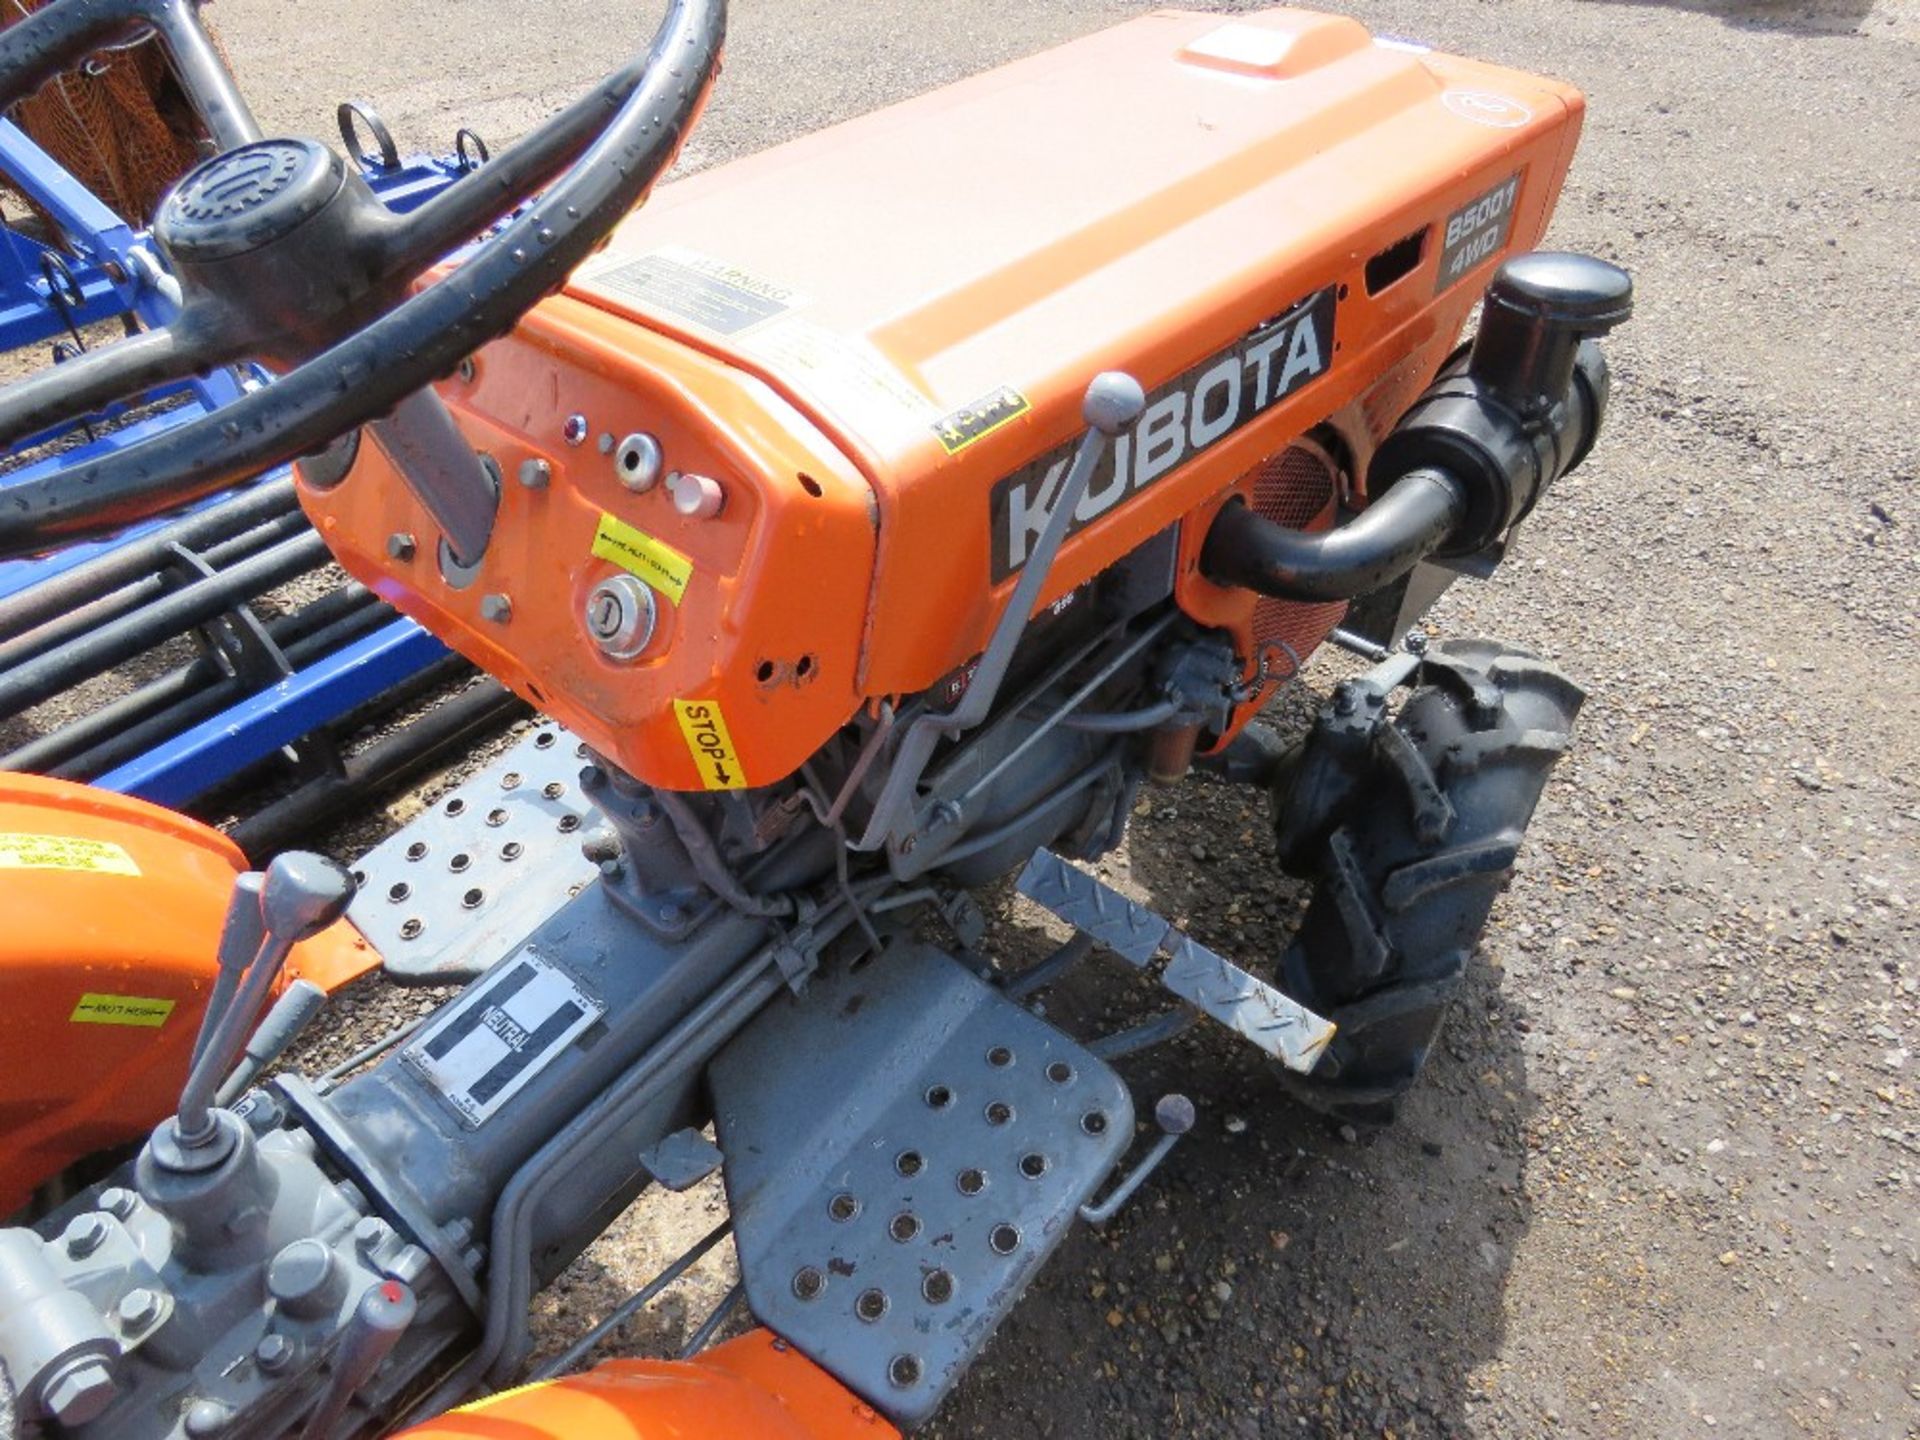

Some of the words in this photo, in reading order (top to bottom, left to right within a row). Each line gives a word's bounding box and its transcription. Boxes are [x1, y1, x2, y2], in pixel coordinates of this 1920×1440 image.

[1445, 181, 1516, 249] B5001
[1450, 224, 1498, 274] 4WD
[1009, 313, 1322, 568] KUBOTA
[685, 706, 725, 759] STOP
[480, 1005, 531, 1053] NEUTRAL
